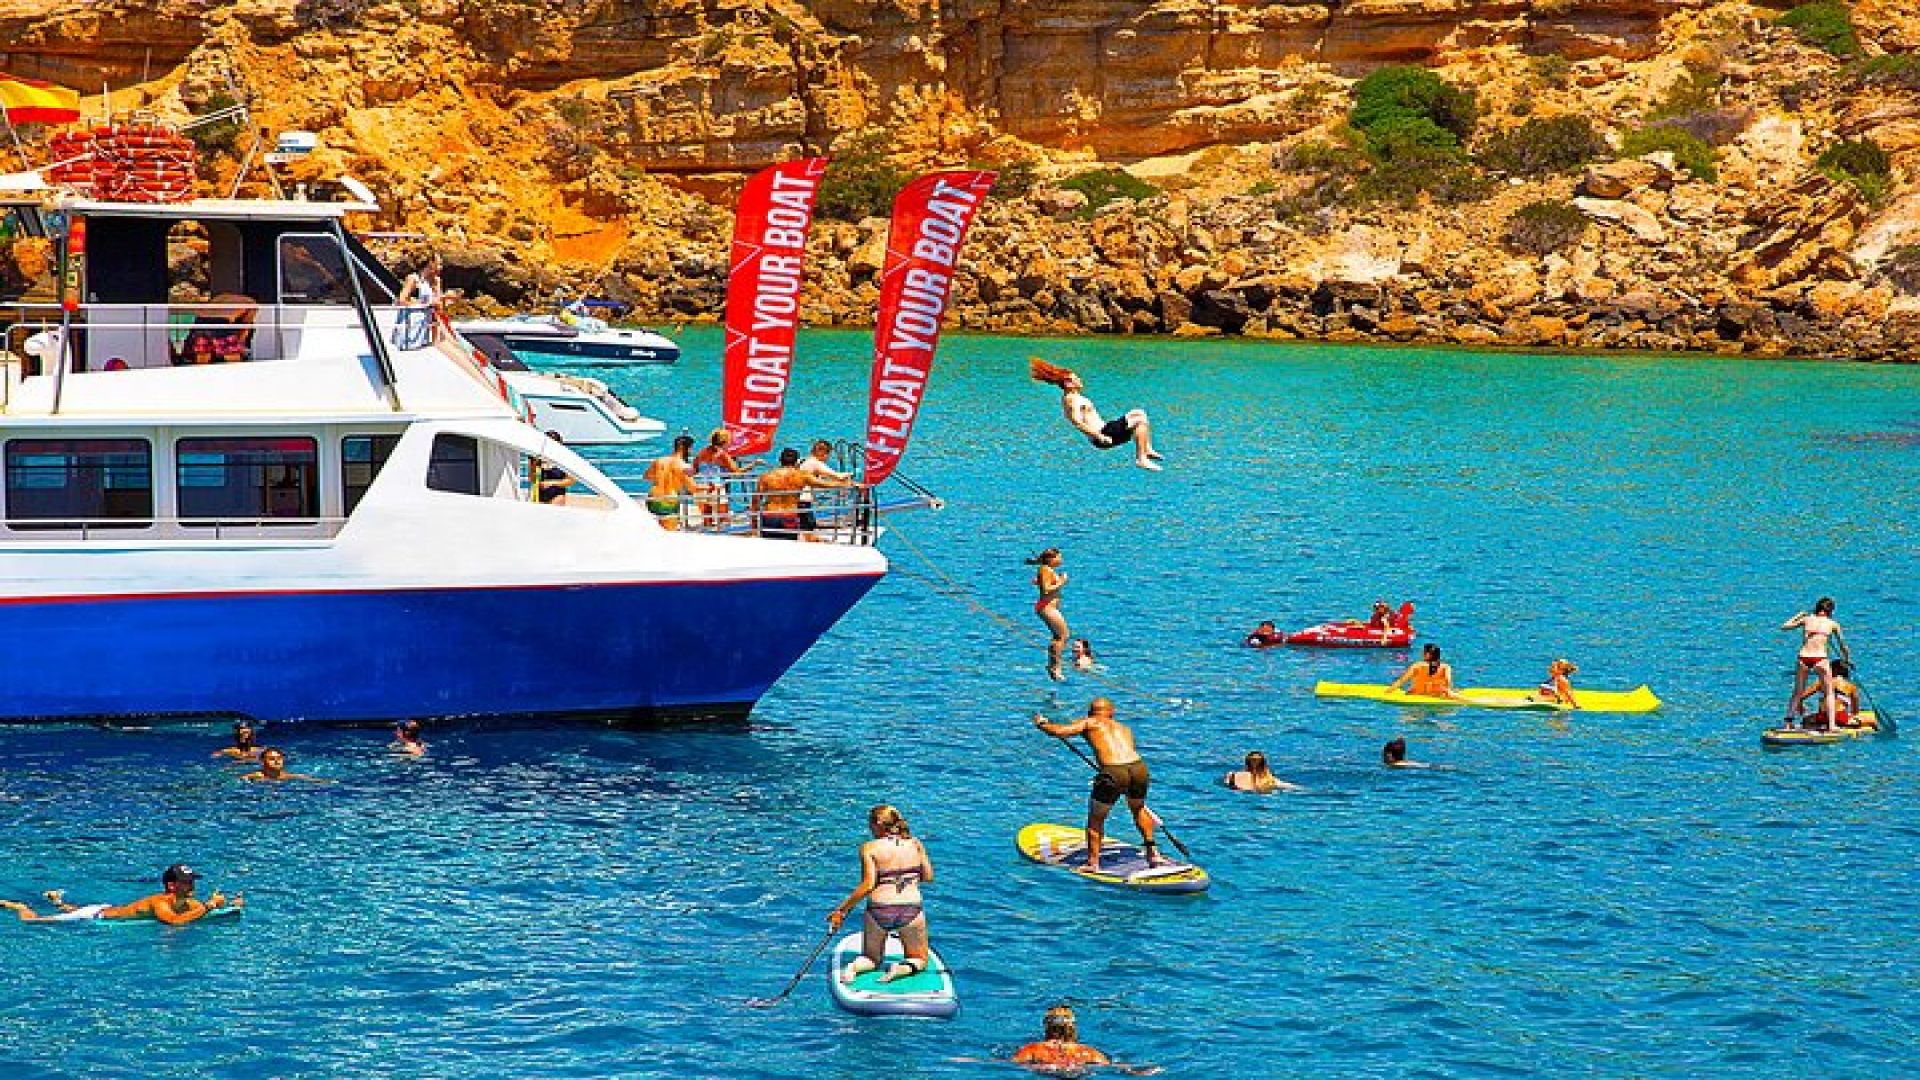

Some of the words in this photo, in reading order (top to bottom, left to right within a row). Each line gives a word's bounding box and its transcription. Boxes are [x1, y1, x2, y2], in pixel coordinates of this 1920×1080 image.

[763, 171, 816, 249] BOAT
[912, 179, 977, 267] BOAT
[751, 255, 800, 331] YOUR
[889, 269, 948, 352] YOUR
[740, 337, 790, 426] FLOAT
[866, 357, 926, 456] FLOAT
